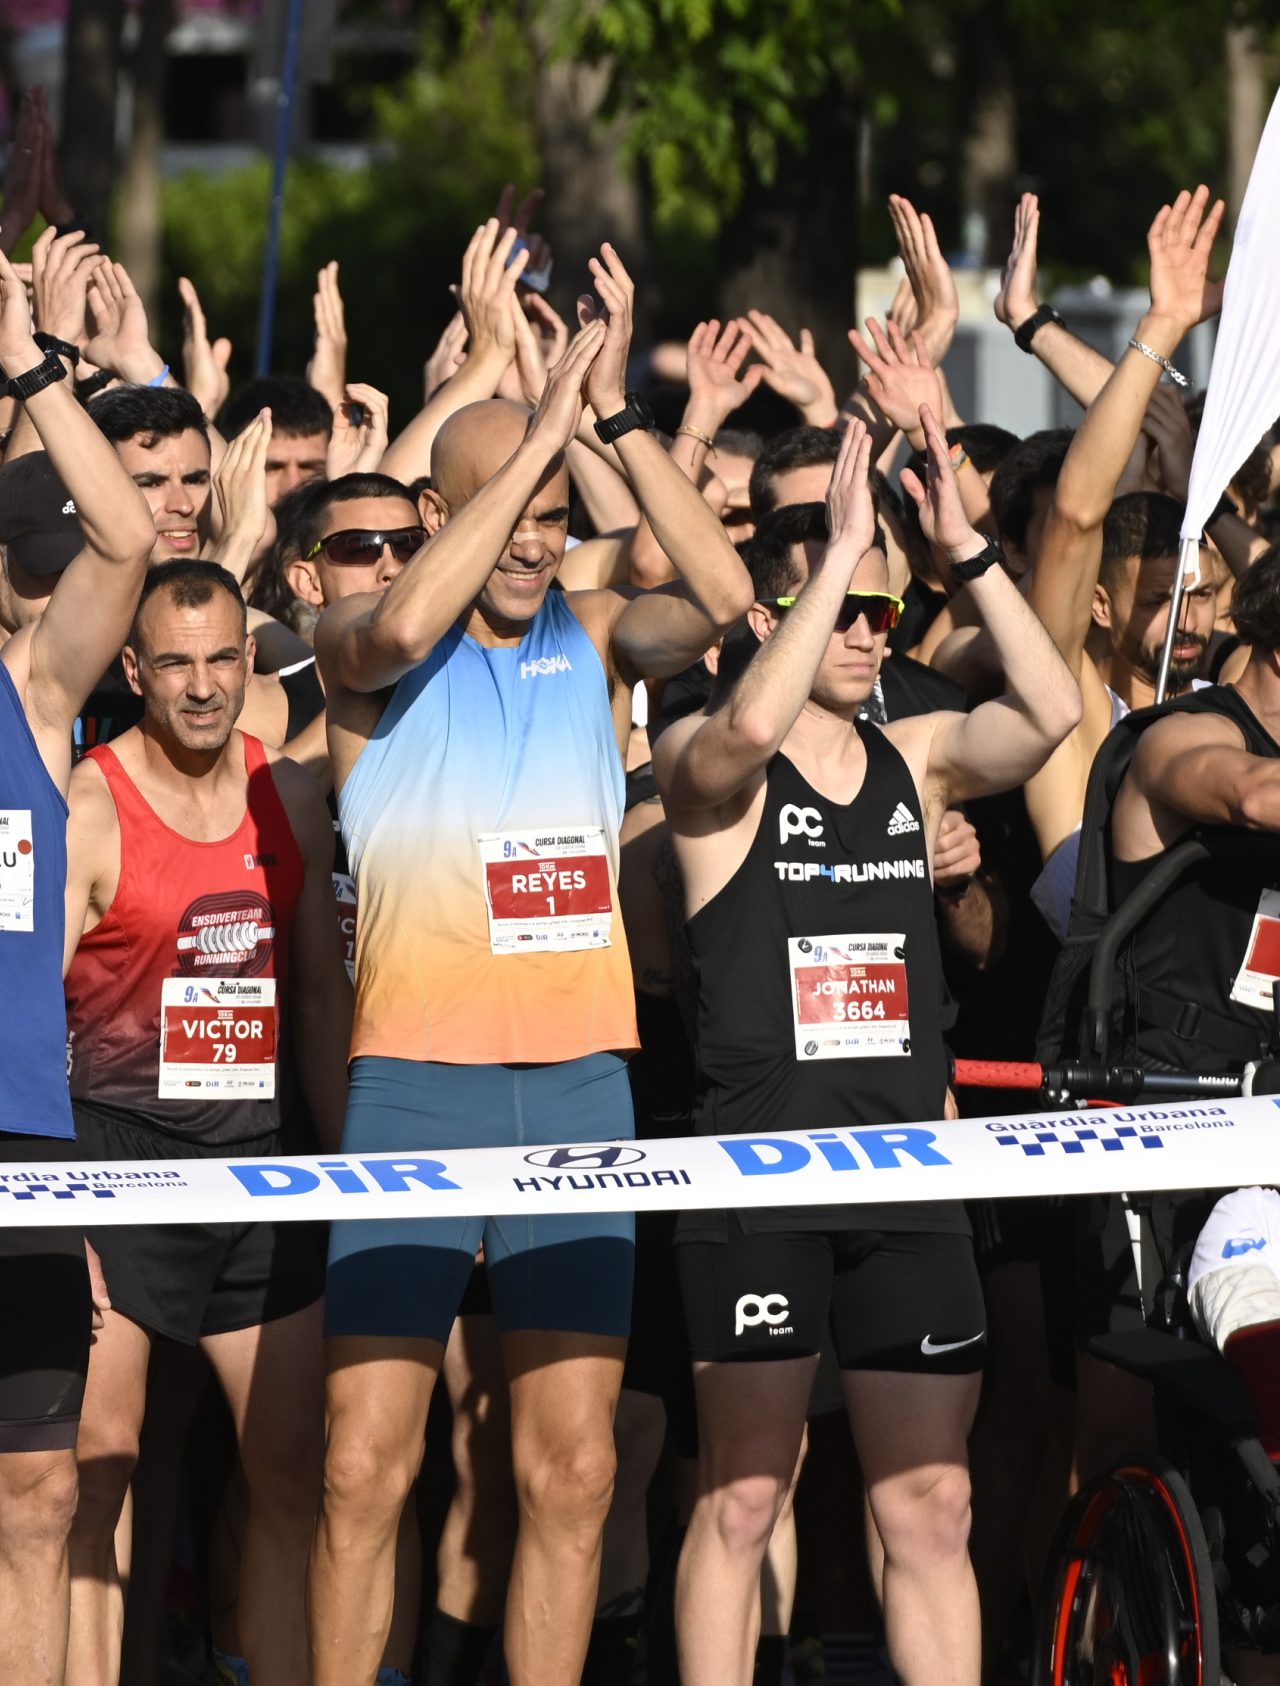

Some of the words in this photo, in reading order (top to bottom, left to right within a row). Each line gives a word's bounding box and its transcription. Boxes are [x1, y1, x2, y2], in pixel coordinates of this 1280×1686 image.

[520, 653, 573, 680] HOKA
[887, 820, 920, 836] adidas
[503, 840, 518, 859] 9A
[535, 837, 556, 848] CURSA
[808, 838, 826, 848] team
[773, 859, 925, 882] TOP4RUNNING
[512, 870, 587, 894] REYES
[545, 896, 556, 916] 1
[191, 907, 263, 928] ENSDIVERTEAM
[848, 942, 866, 952] CURSA
[184, 985, 199, 1003] 9A
[217, 985, 236, 995] CURSA
[812, 979, 896, 996] JONATHAN
[832, 1000, 886, 1021] 3664
[181, 1019, 264, 1039] VICTOR
[212, 1042, 237, 1063] 79
[984, 1115, 1107, 1133] Guàrdia
[1112, 1105, 1227, 1122] Urbana
[1138, 1118, 1236, 1133] Barcelona
[716, 1128, 953, 1177] DiR
[65, 1170, 181, 1181] Urbana
[92, 1180, 188, 1190] Barcelona
[226, 1158, 463, 1197] DiR
[512, 1168, 692, 1192] HYUNDAI
[768, 1326, 794, 1337] team
